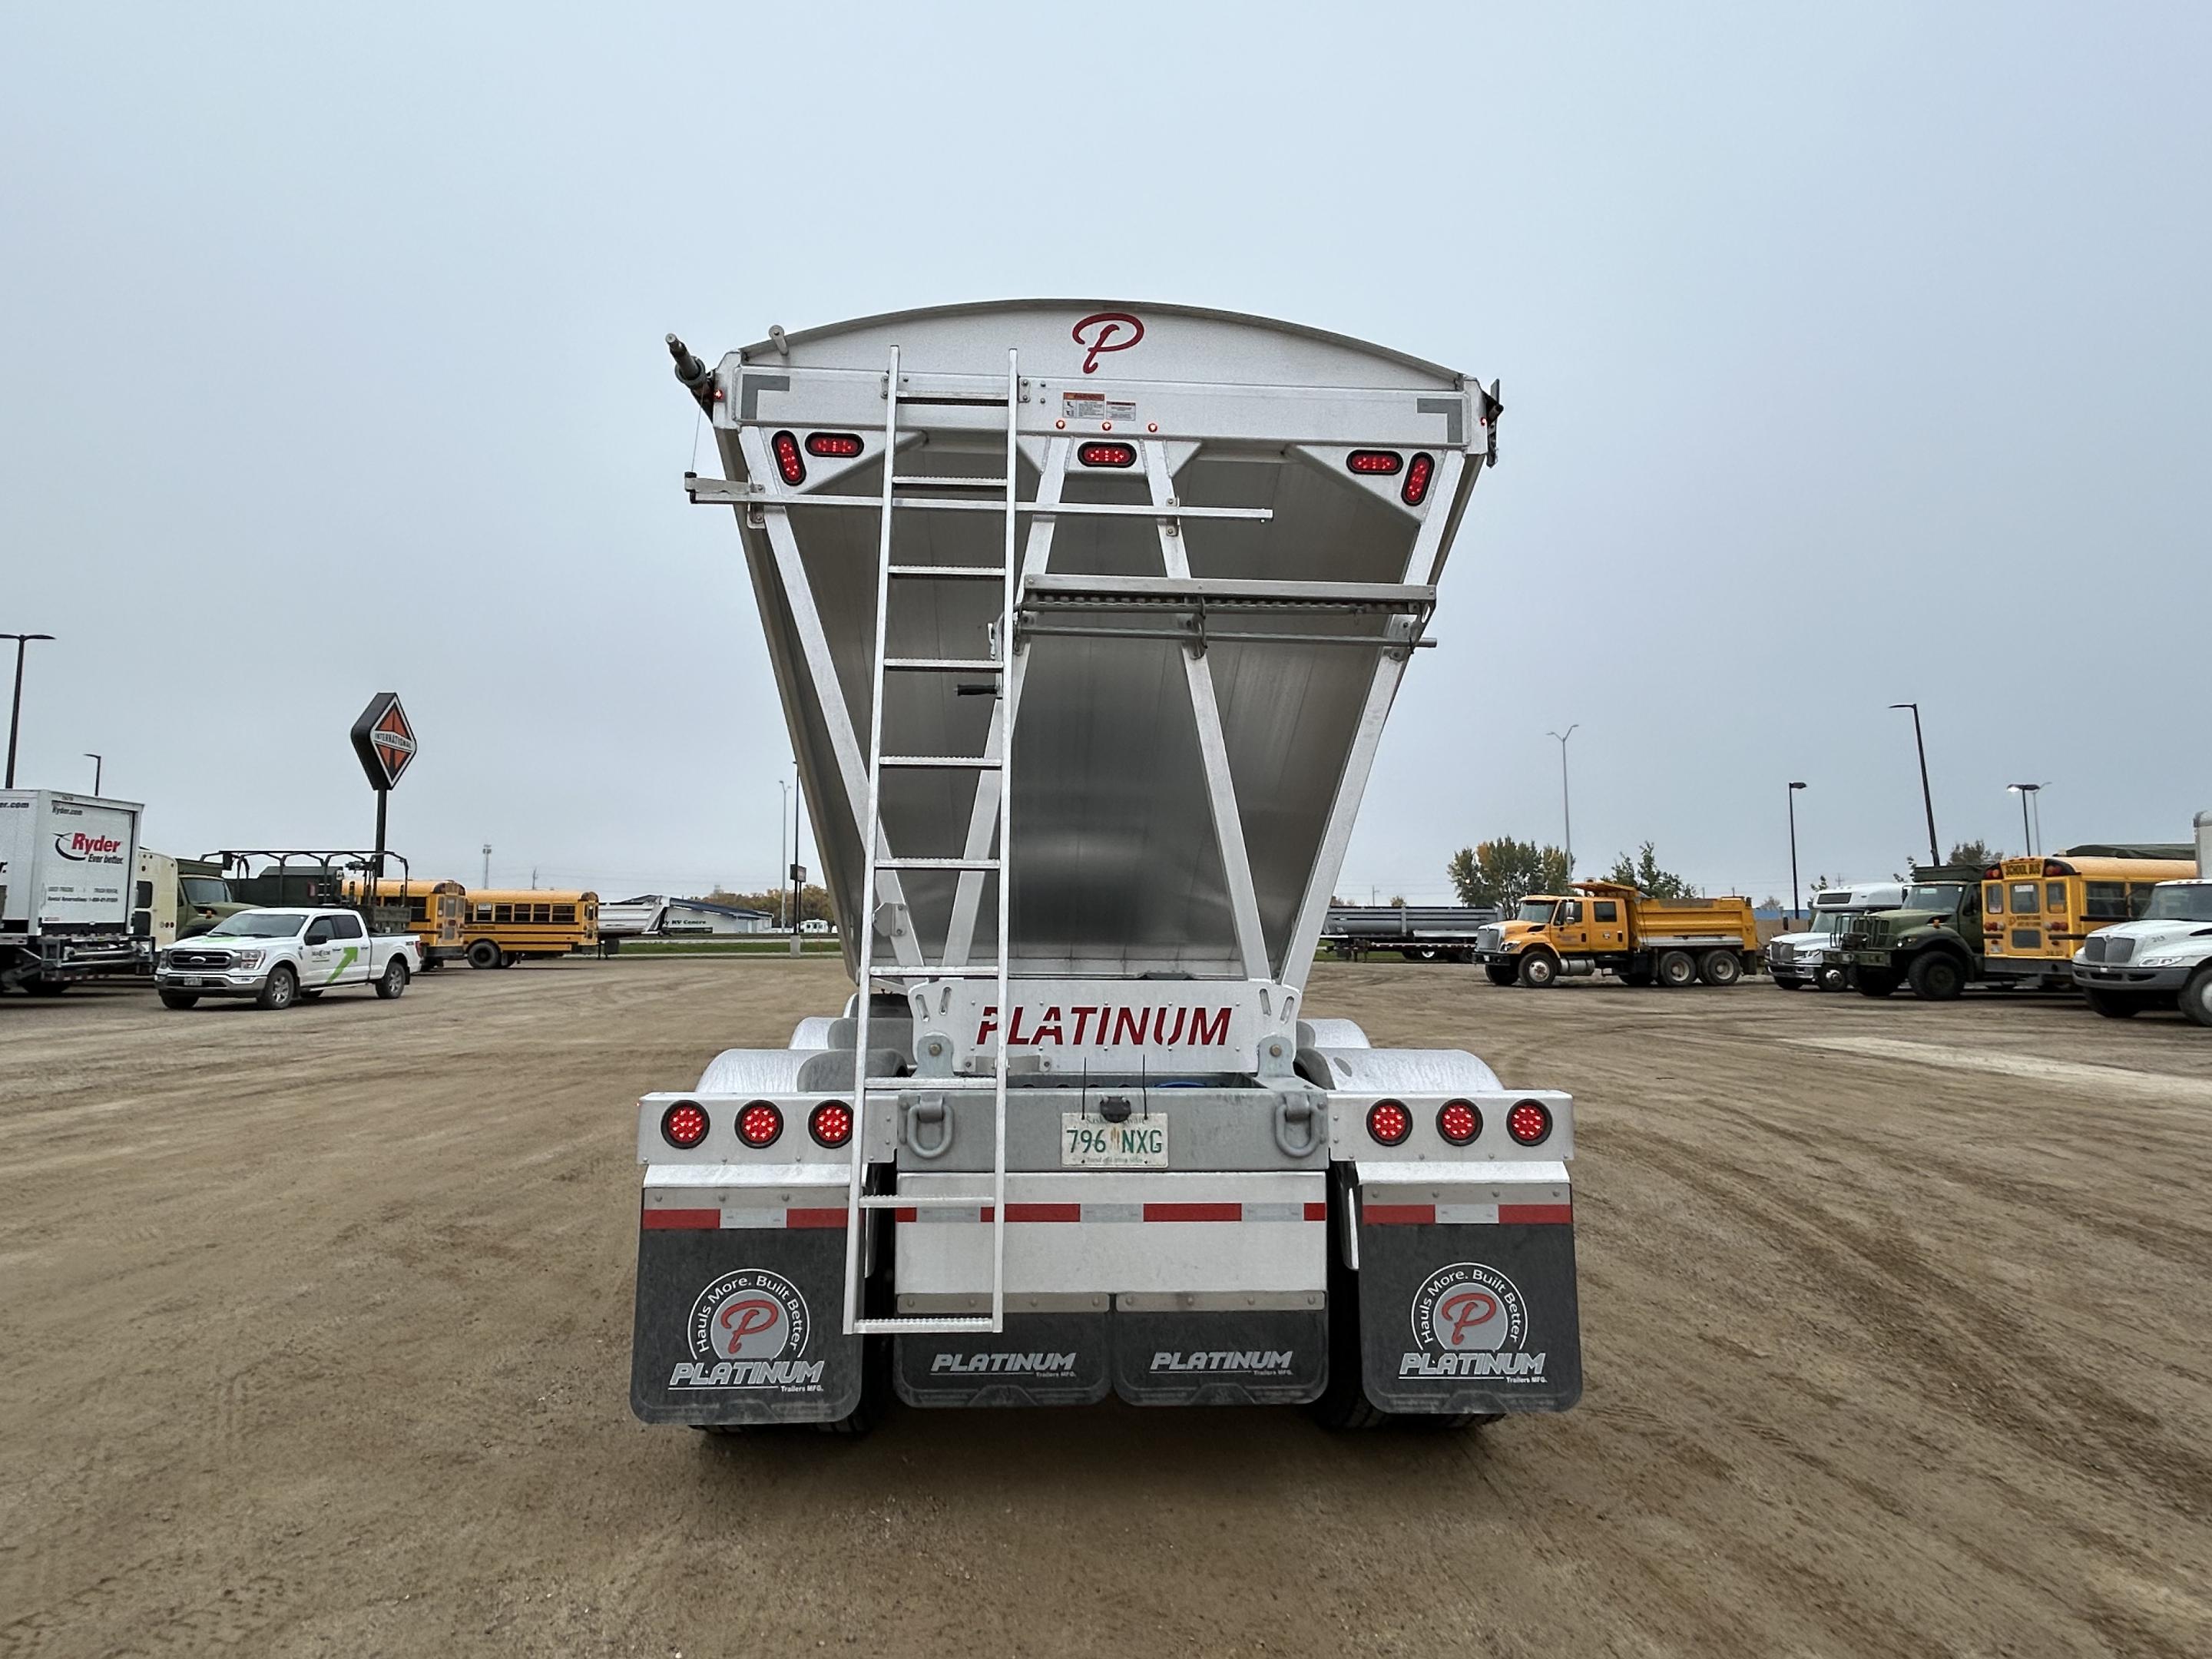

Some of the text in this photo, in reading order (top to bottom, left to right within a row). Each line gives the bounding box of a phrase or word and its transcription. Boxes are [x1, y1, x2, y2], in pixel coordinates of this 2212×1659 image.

[71, 833, 121, 855] Ryder
[2005, 864, 2041, 875] SCHOOL BUS
[976, 1006, 1232, 1045] PLATINUM
[1066, 1129, 1162, 1154] 796 NXG
[696, 1275, 803, 1353] Hauls More. Built Better
[1419, 1269, 1522, 1343] Hauls More. Built Better
[931, 1353, 1076, 1372] PLATINUM
[1151, 1350, 1293, 1370] PLATINUM
[1399, 1353, 1546, 1375] PLATINUM
[669, 1360, 825, 1385] PLATINUM
